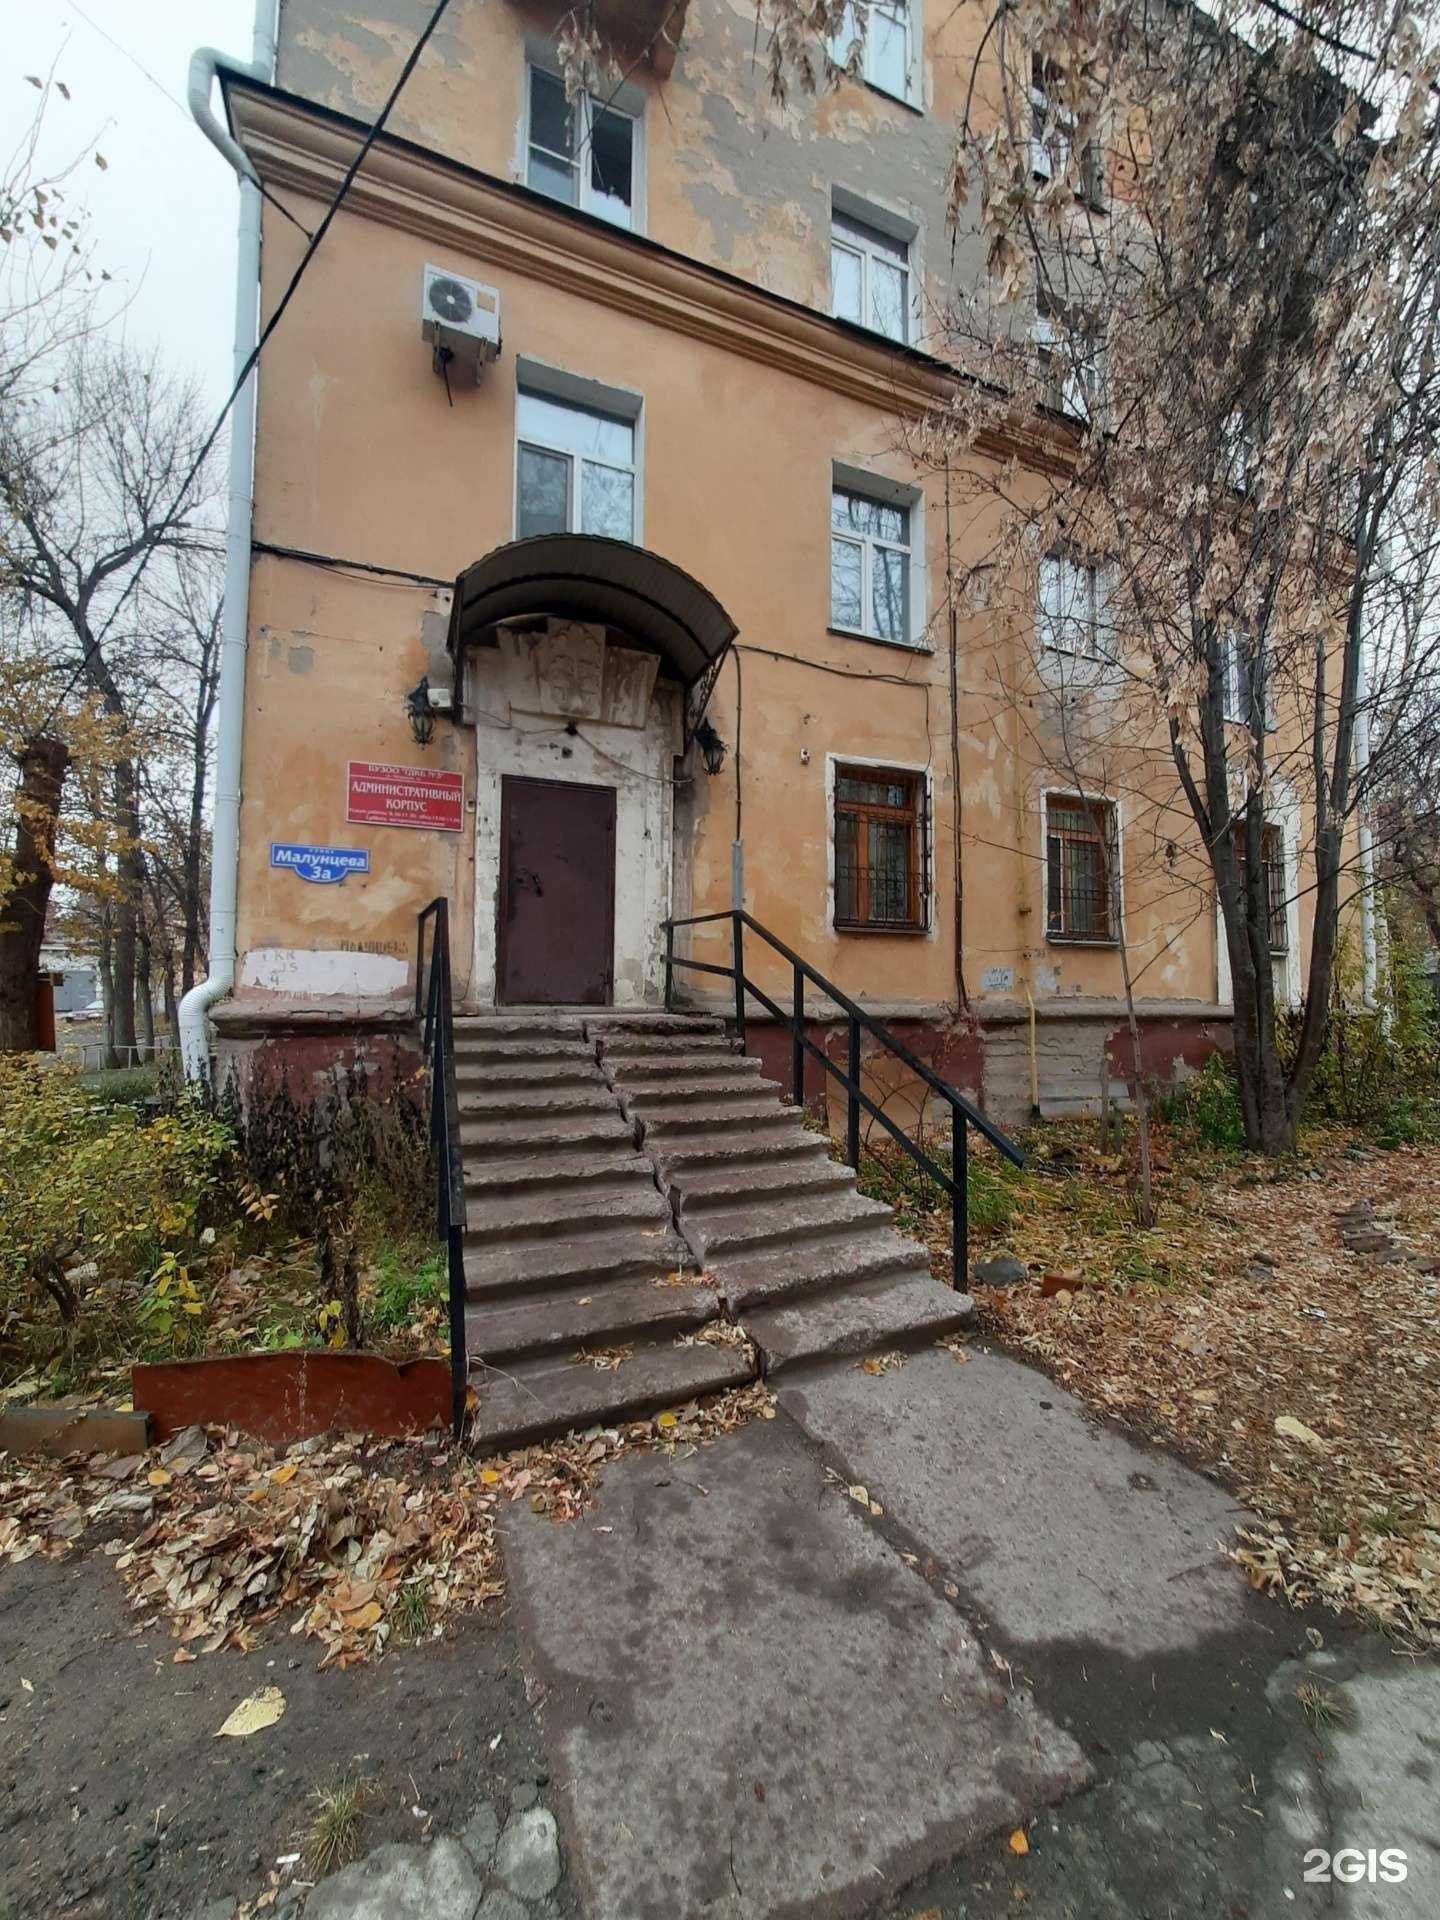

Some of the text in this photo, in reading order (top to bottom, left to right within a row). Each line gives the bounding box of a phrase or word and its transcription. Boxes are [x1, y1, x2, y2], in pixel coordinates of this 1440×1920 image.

[351, 781, 461, 802] АДМИНИСТРАТИВНЫЙ
[386, 799, 427, 812] КОРПУС
[275, 850, 365, 867] Малунцева
[310, 866, 331, 880] 3а
